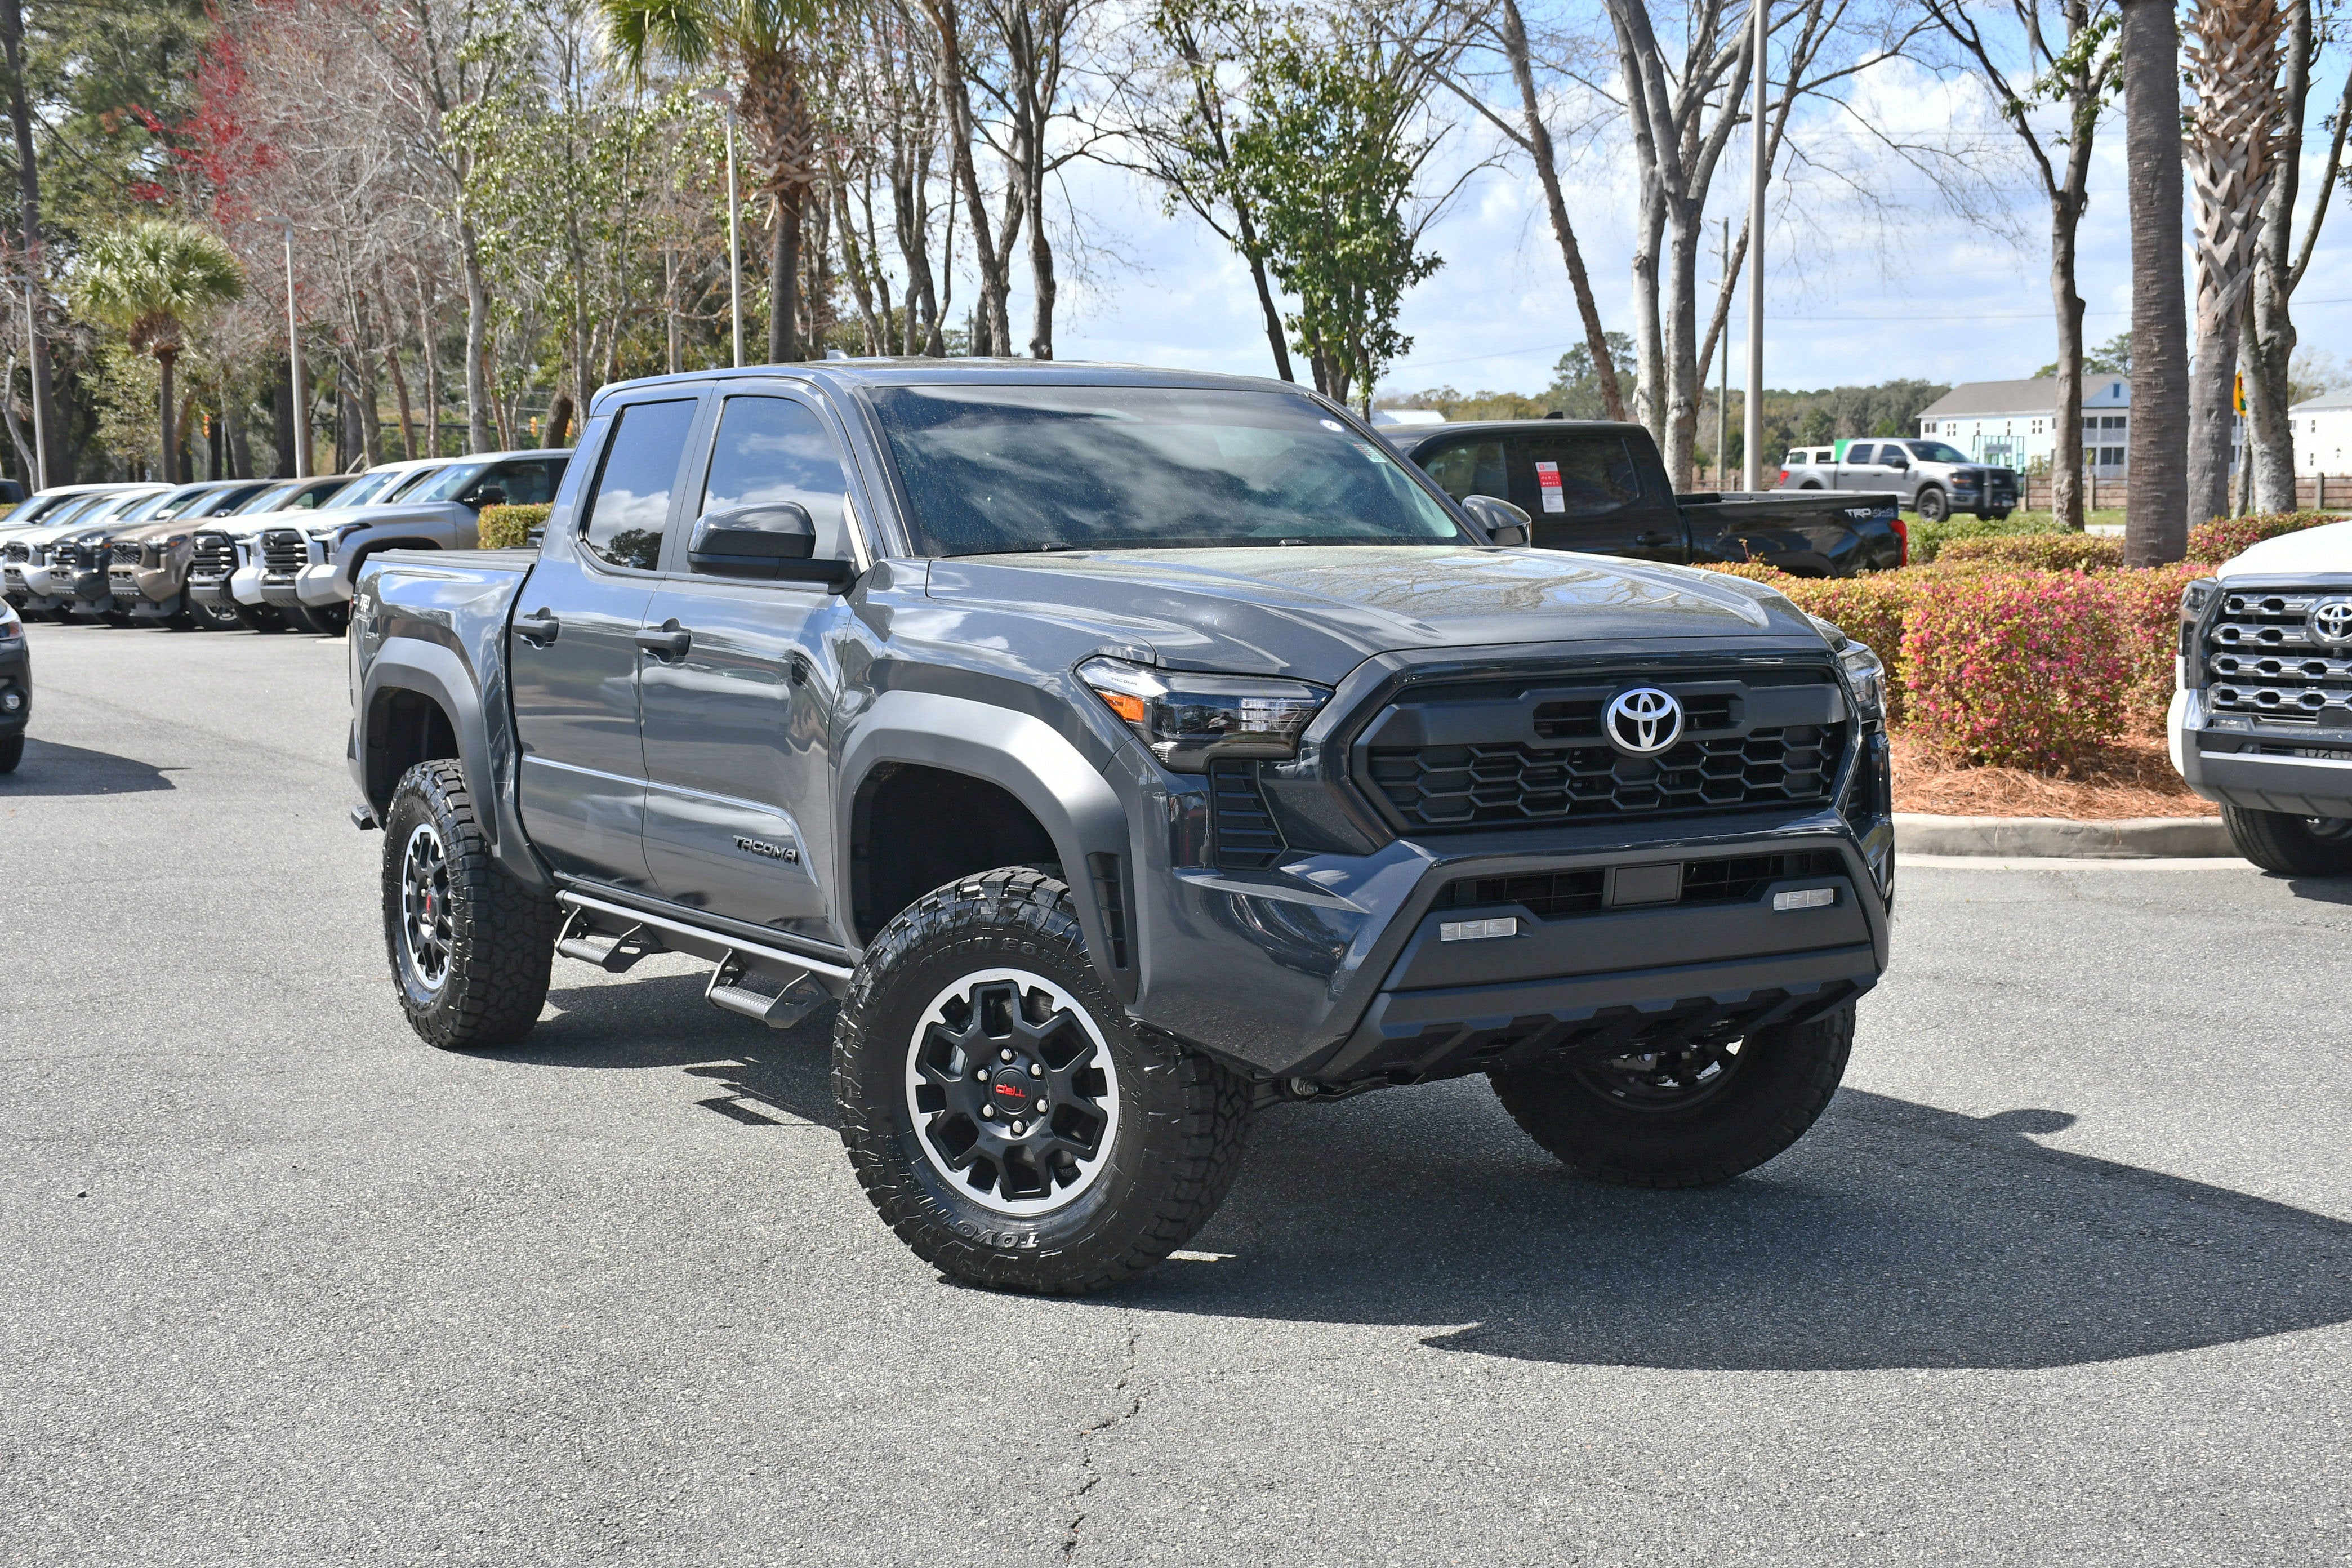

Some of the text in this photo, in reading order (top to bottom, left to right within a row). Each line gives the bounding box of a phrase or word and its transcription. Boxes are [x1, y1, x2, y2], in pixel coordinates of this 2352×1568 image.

[1844, 508, 1871, 518] TRD
[359, 594, 371, 613] TRD
[1111, 677, 1138, 686] TACOMA
[733, 835, 799, 865] TACOMA
[995, 1084, 1026, 1098] TRD
[954, 1220, 1040, 1250] TOYO
